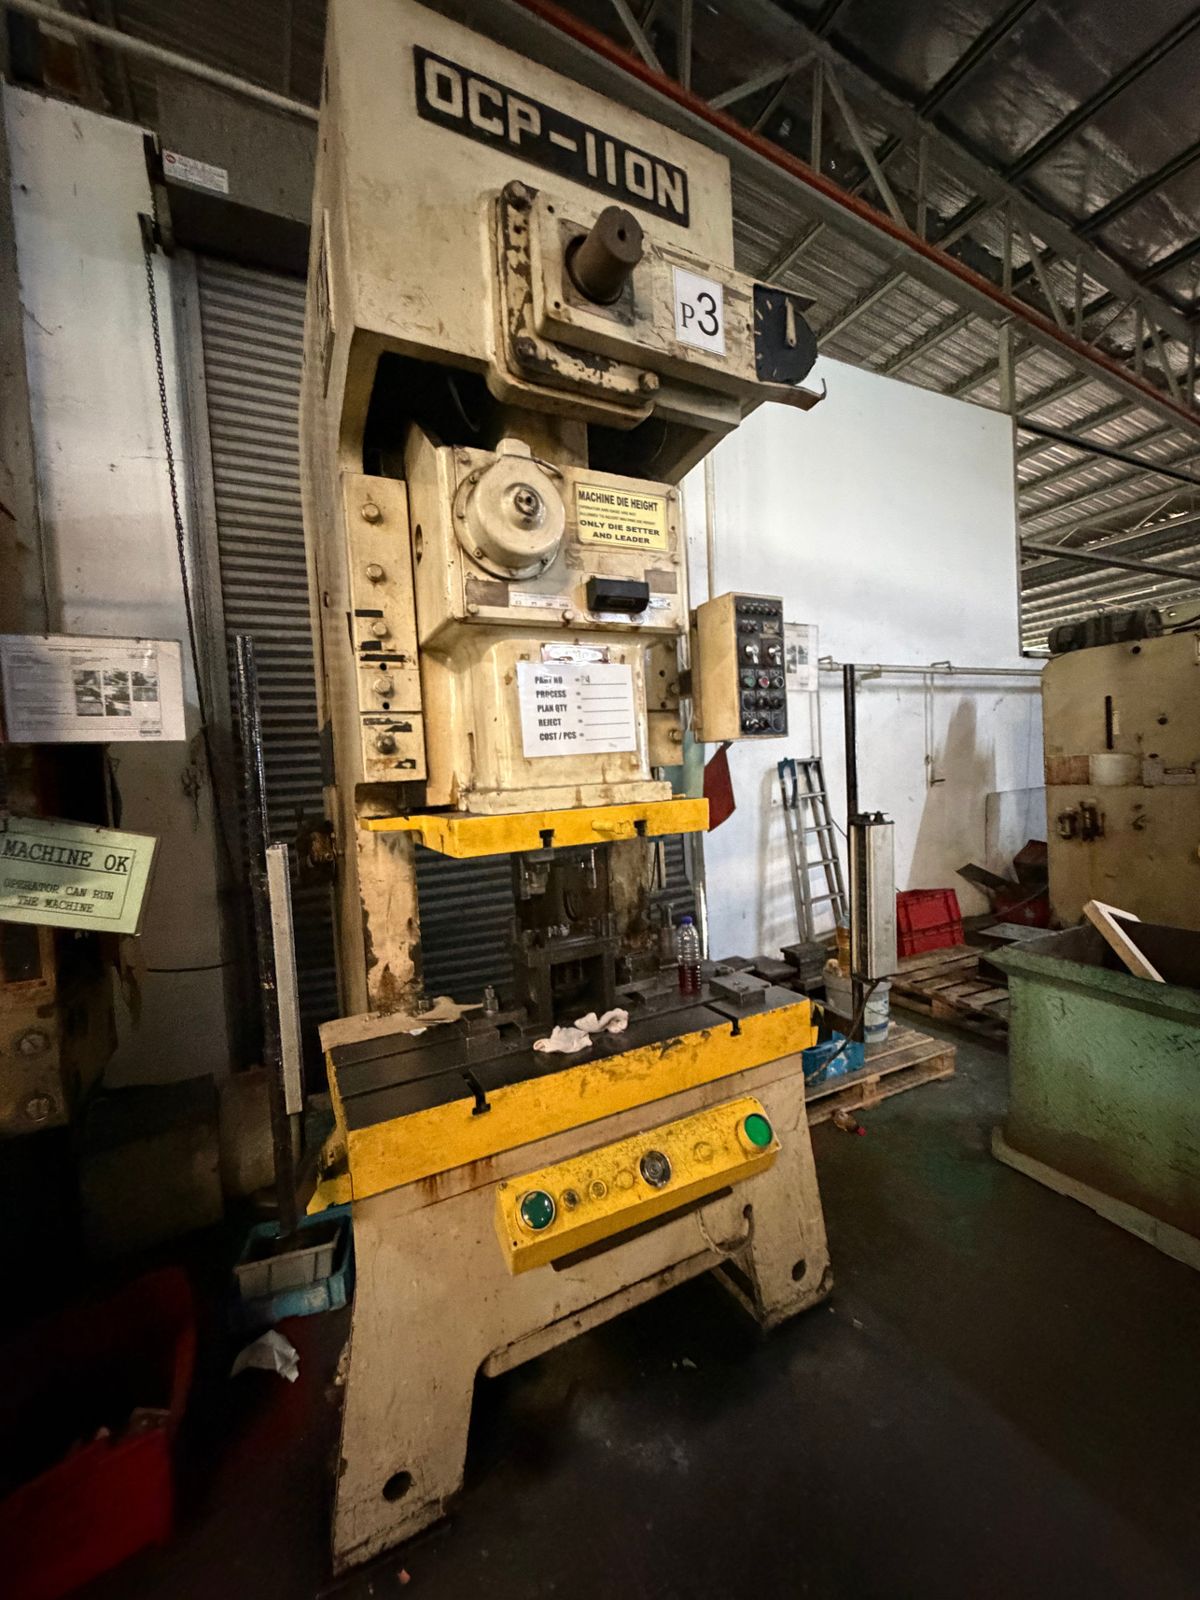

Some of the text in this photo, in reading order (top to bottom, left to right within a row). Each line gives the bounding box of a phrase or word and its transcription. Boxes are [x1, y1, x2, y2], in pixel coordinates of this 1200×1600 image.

[424, 56, 685, 215] OCP-110N
[578, 490, 615, 505] MACHINE
[616, 496, 629, 507] DIE
[630, 499, 658, 512] HEIGHT
[580, 519, 660, 536] ONLY DIE SETTER
[592, 531, 650, 544] AND LEADER
[553, 676, 563, 684] NO
[536, 690, 567, 698] PROCESS
[537, 704, 568, 713] PLAN QTY
[538, 718, 562, 727] REJECT
[539, 732, 557, 741] COST
[563, 731, 577, 740] PCS
[3, 838, 130, 873] MACHINE OK
[4, 878, 114, 900] OPERATOR CAN RUN
[17, 895, 95, 913] THE MACHINE
